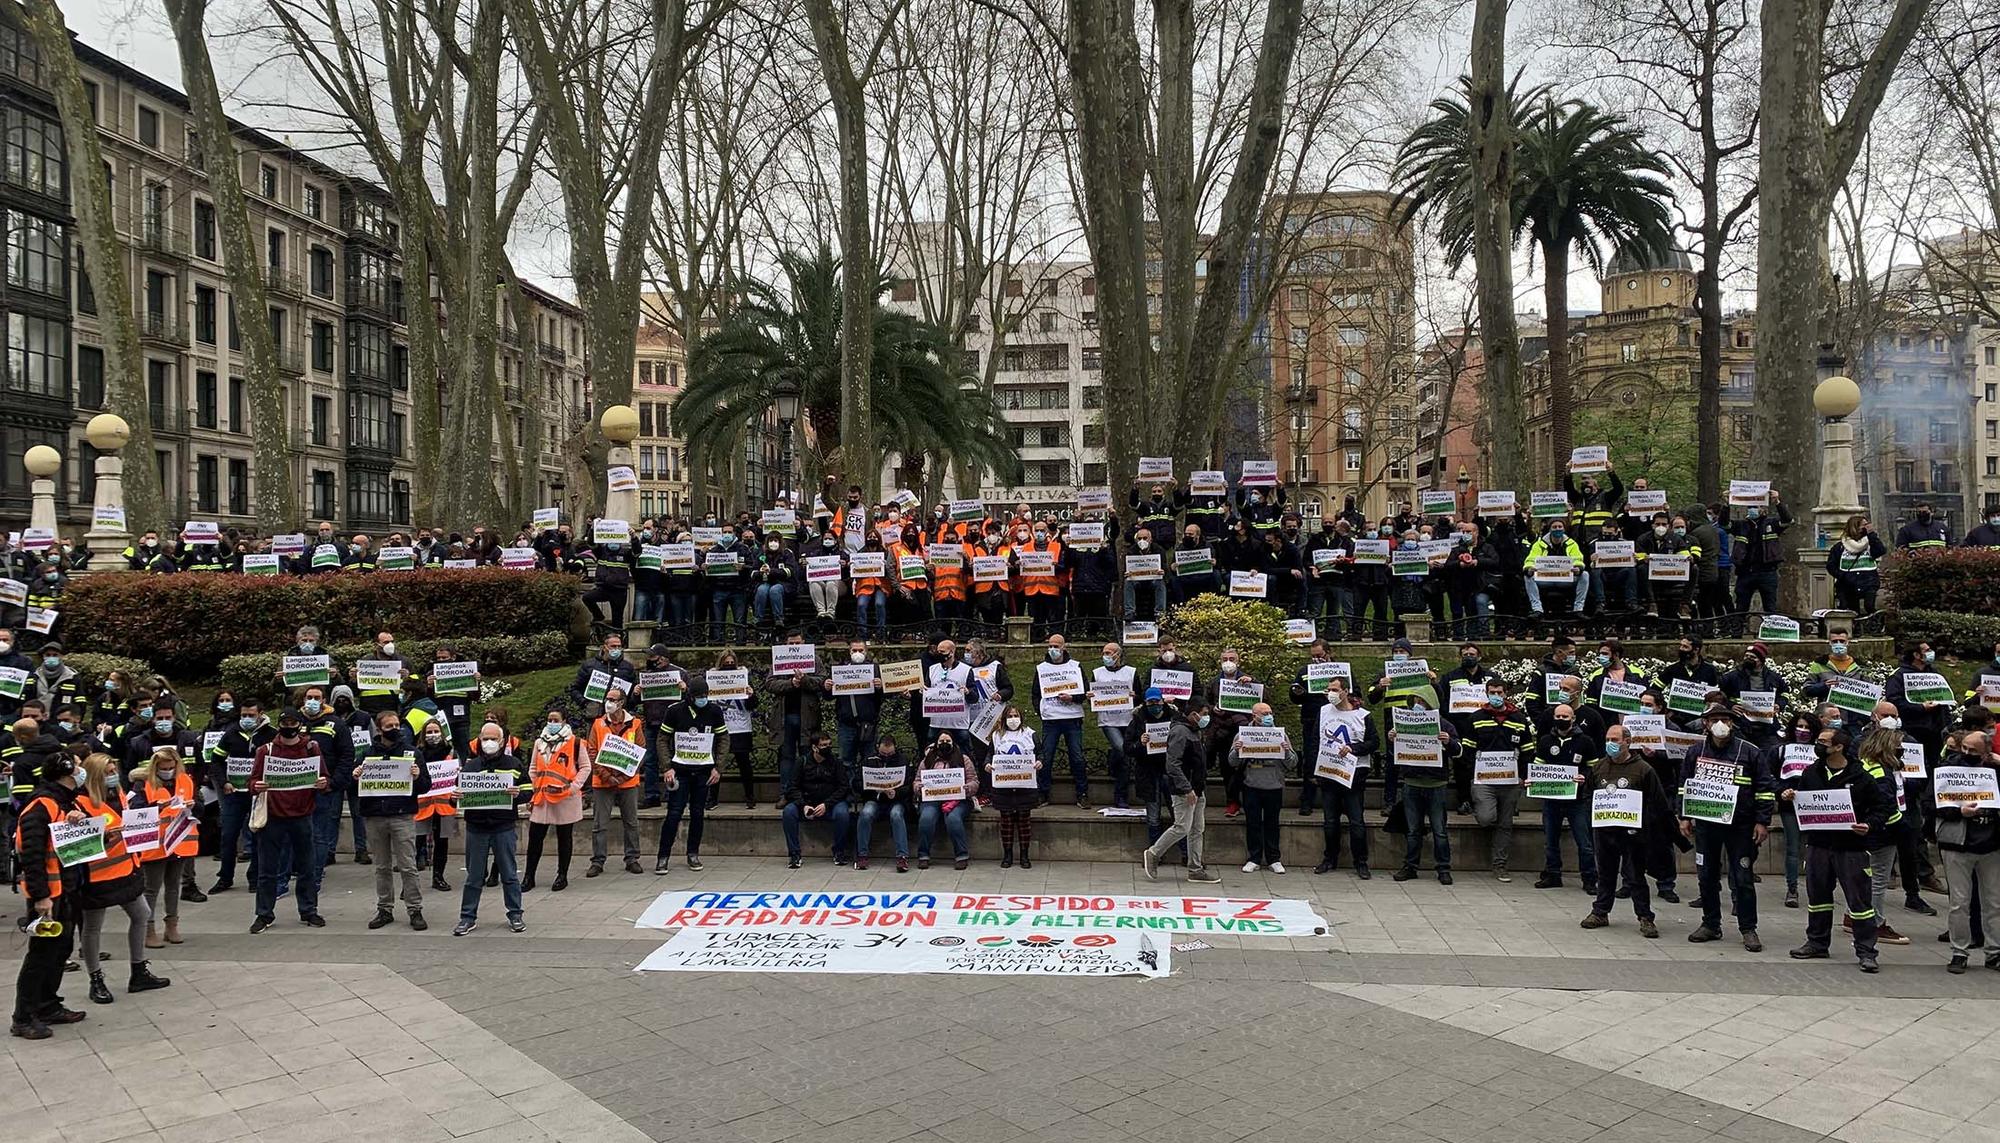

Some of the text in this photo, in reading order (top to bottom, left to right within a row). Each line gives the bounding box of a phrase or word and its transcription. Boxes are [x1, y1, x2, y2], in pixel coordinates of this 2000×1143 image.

[285, 656, 318, 664] Langileok
[1388, 661, 1419, 669] Langileok
[1388, 667, 1427, 675] BORROKAN
[1835, 676, 1870, 690] Langileok
[1222, 687, 1259, 697] BORROKAN
[1604, 686, 1640, 698] BORROKA
[1673, 686, 1705, 698] BORROK
[1834, 683, 1876, 698] BORROKAN
[1395, 708, 1427, 717] Langileok
[1395, 714, 1435, 722] BORROKAN
[604, 741, 639, 759] BORROKAN
[268, 758, 307, 766] Langileok
[362, 763, 399, 771] Enpleguaren
[1530, 765, 1566, 773] Langileok
[1696, 762, 1735, 773] TUBACEX
[430, 769, 459, 779] istración
[461, 774, 500, 782] Langileok
[1530, 772, 1574, 780] BORROKAN
[1707, 770, 1734, 779] SALBA
[361, 781, 410, 790] INPLIKAZIOA!!
[461, 781, 509, 789] BORROKAN
[1687, 781, 1725, 792] Langileok
[1687, 788, 1733, 801] BORROKAN
[1937, 792, 1979, 801] Despidorik
[1594, 802, 1618, 810] defentsan
[1797, 802, 1851, 811] Administración
[1594, 811, 1638, 821] INPLIKAZIOA!!
[685, 892, 936, 909] AERNNOVA
[1181, 898, 1276, 919] EZ
[664, 909, 1285, 932] READMISION HAY ALTERNATIVAS
[853, 933, 908, 948] 34
[705, 941, 845, 950] LANGILEAK
[680, 959, 827, 967] LANGILERIA
